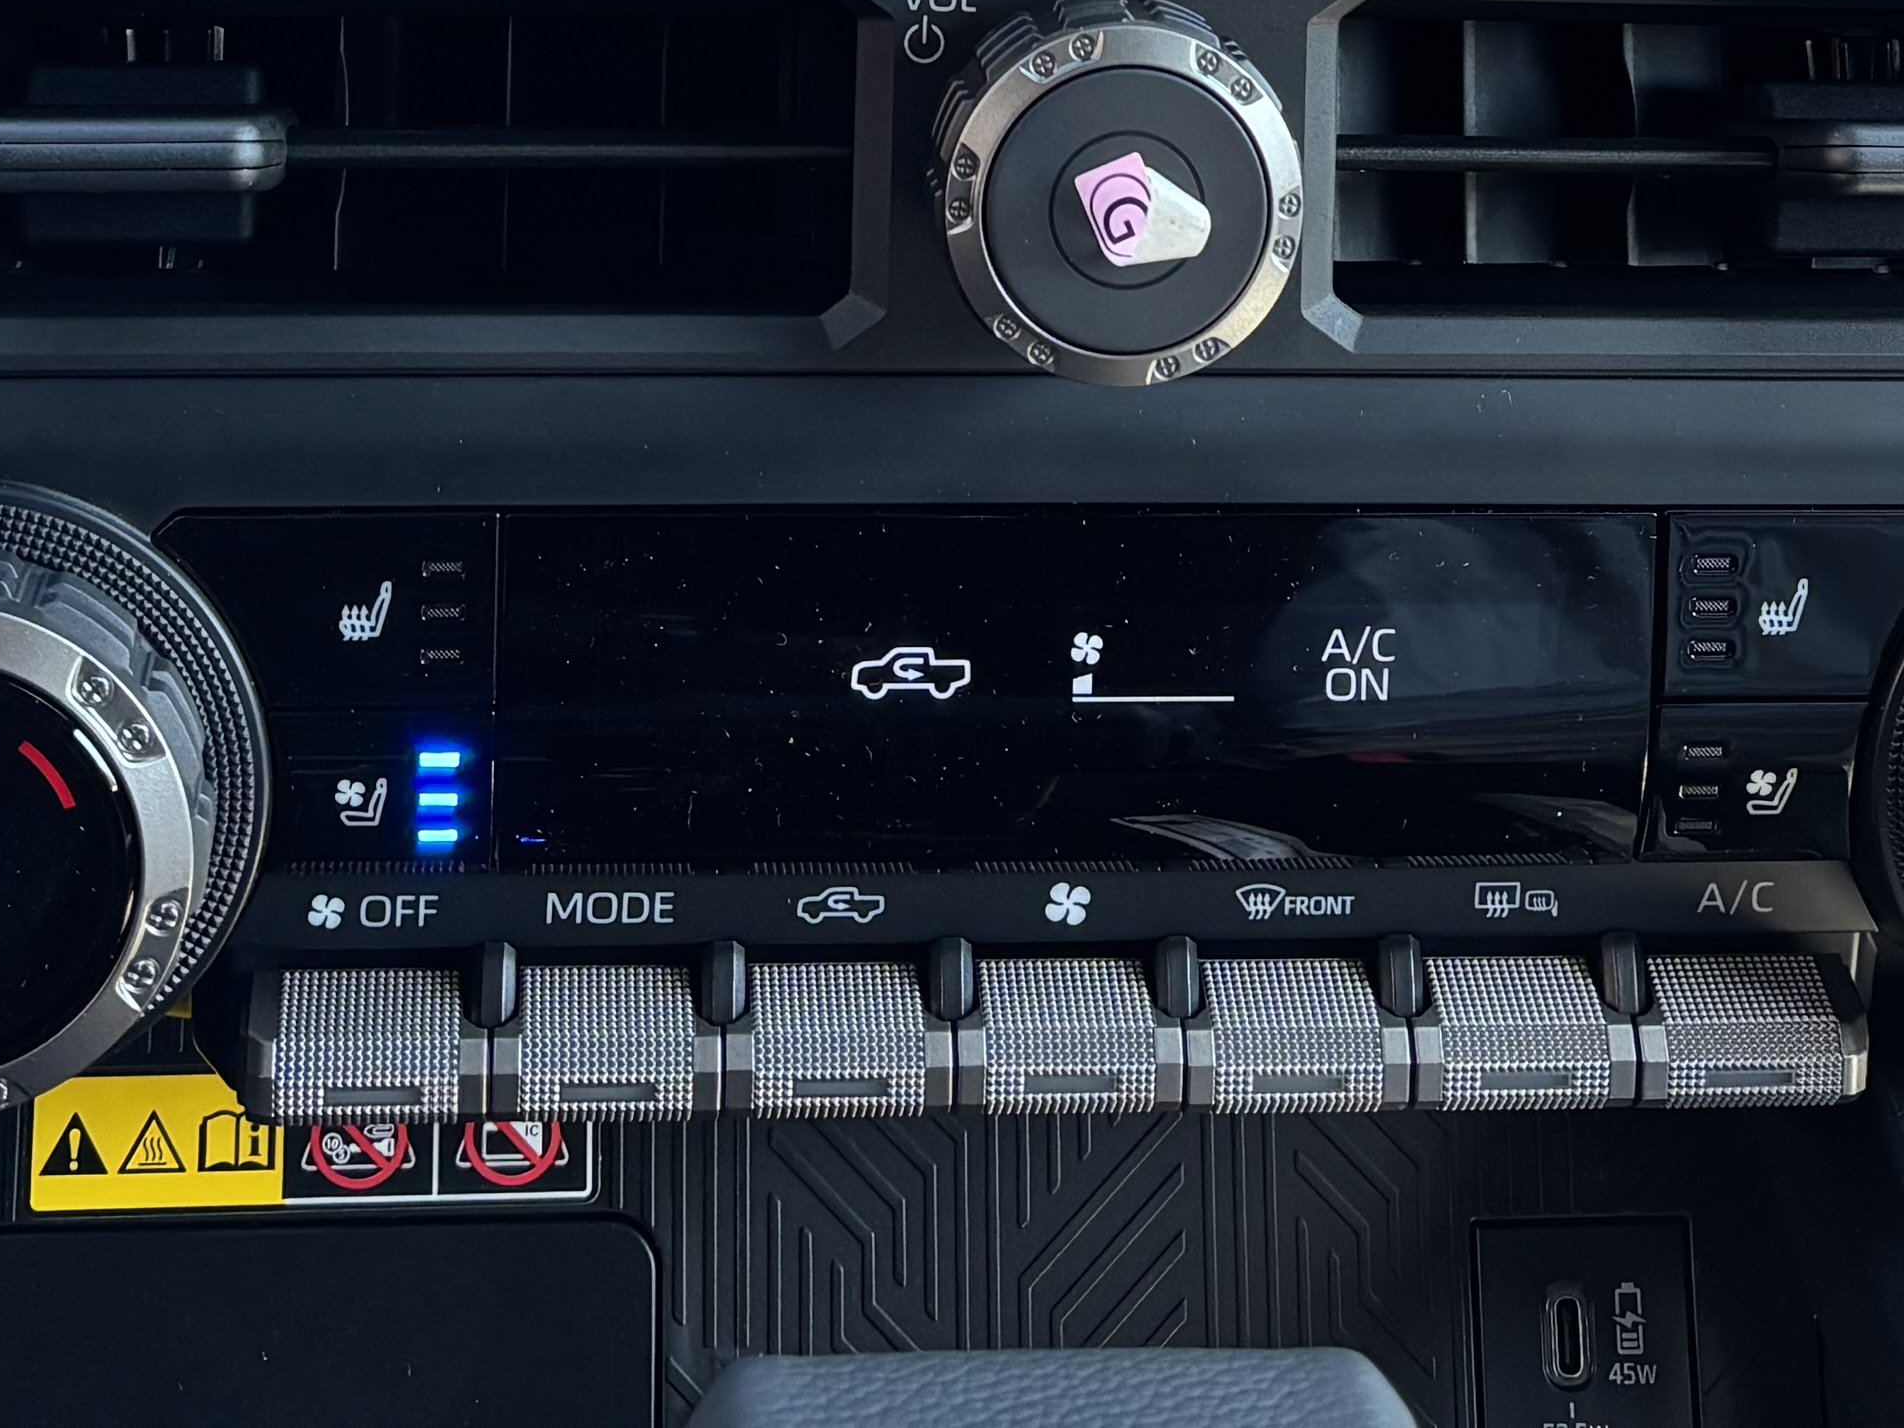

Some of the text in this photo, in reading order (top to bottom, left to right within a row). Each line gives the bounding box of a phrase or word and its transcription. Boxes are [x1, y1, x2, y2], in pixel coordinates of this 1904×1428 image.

[1322, 626, 1395, 664] A/C
[1326, 668, 1388, 701] ON
[360, 895, 438, 927] OFF
[547, 892, 674, 924] MODE
[1285, 896, 1355, 915] FRONT
[1698, 880, 1774, 914] A/C
[524, 1123, 539, 1137] IC
[1609, 1363, 1656, 1384] 45W
